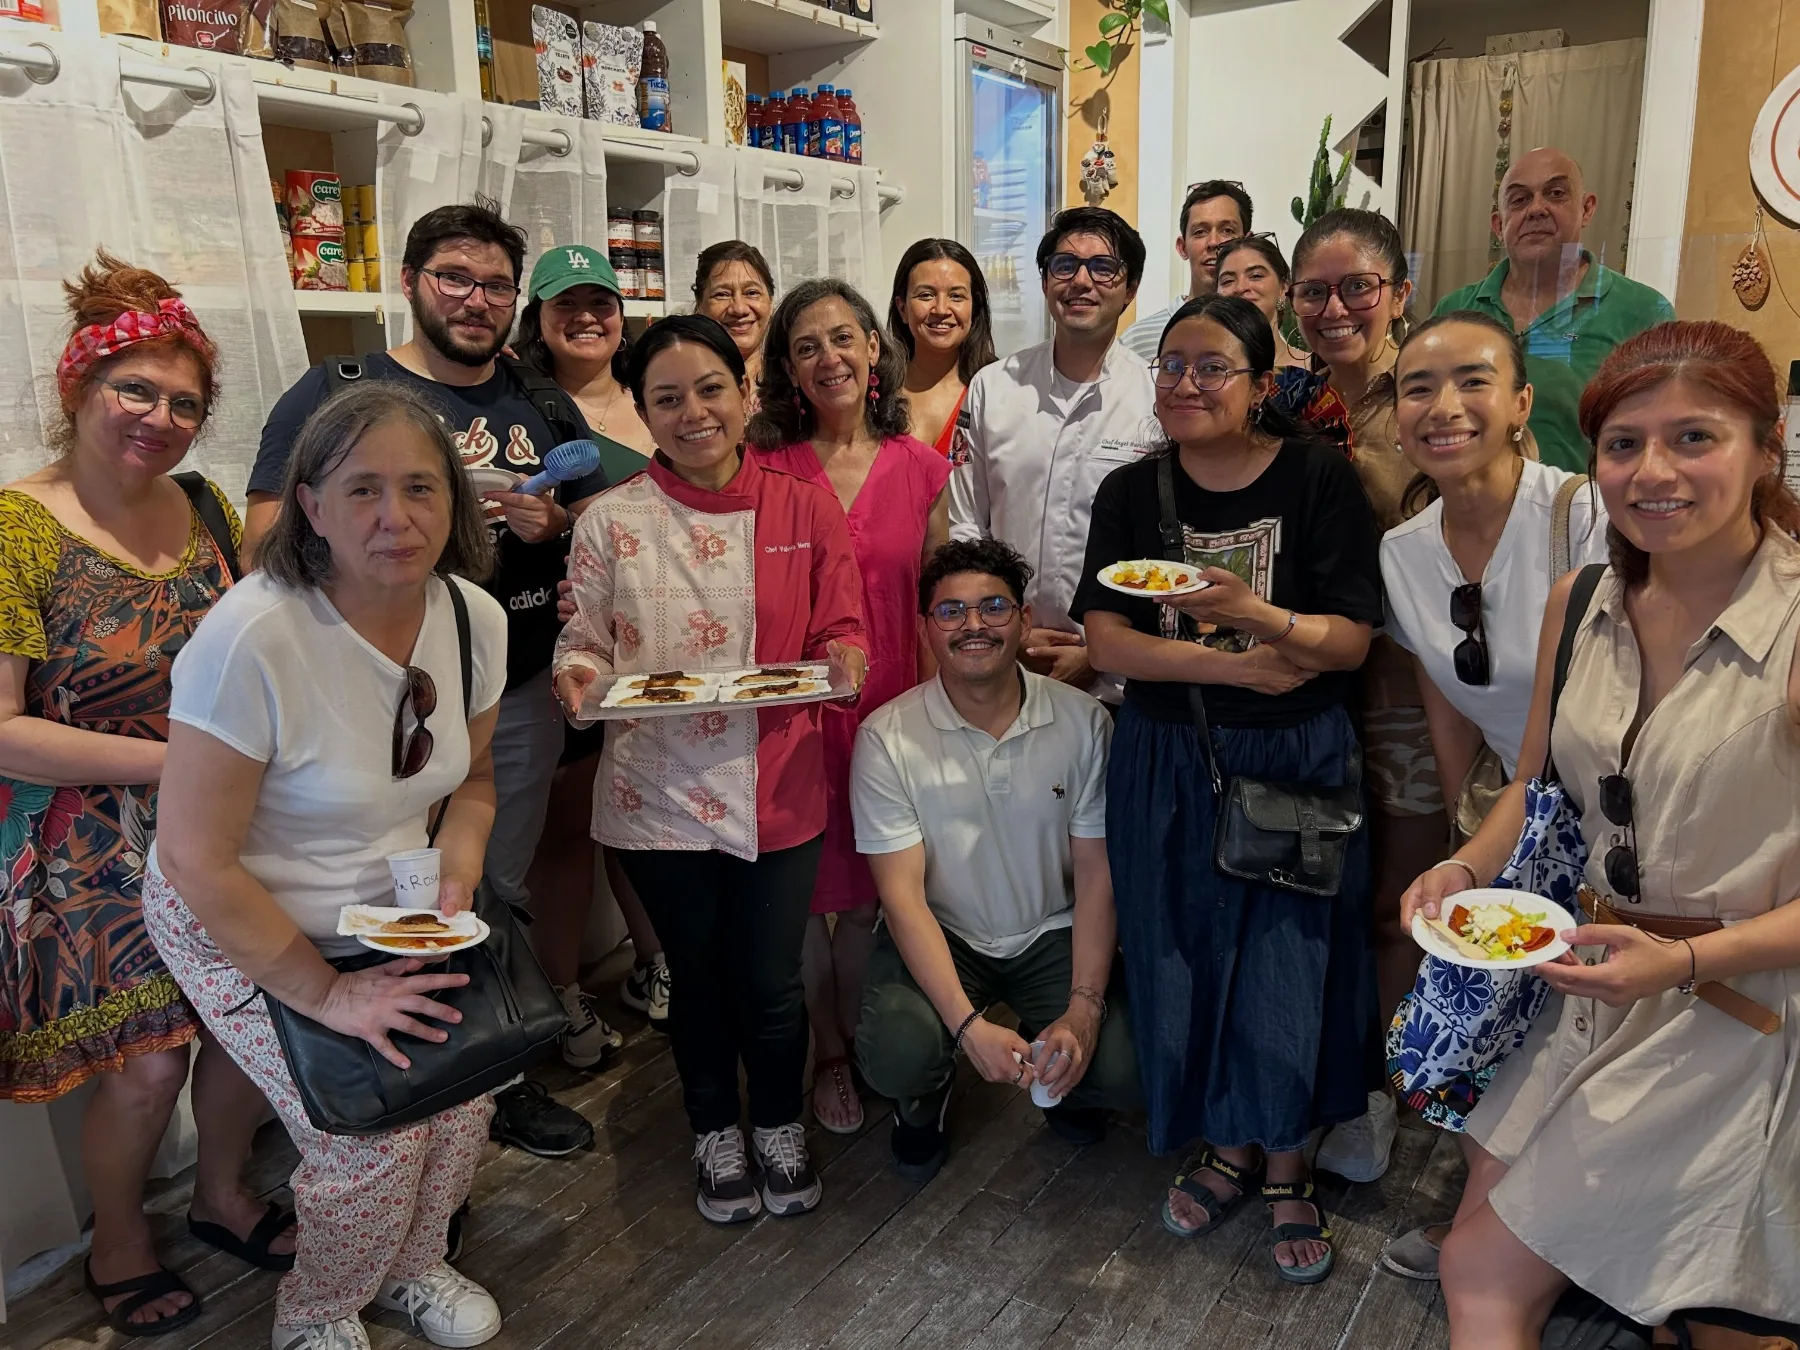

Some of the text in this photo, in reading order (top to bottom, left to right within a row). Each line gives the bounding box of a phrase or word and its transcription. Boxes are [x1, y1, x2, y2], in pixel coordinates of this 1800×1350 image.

[168, 5, 238, 26] Piloncillo
[566, 249, 590, 268] LA
[505, 424, 541, 466] &
[1211, 1158, 1240, 1179] Timberland
[1262, 1186, 1293, 1195] Timberland
